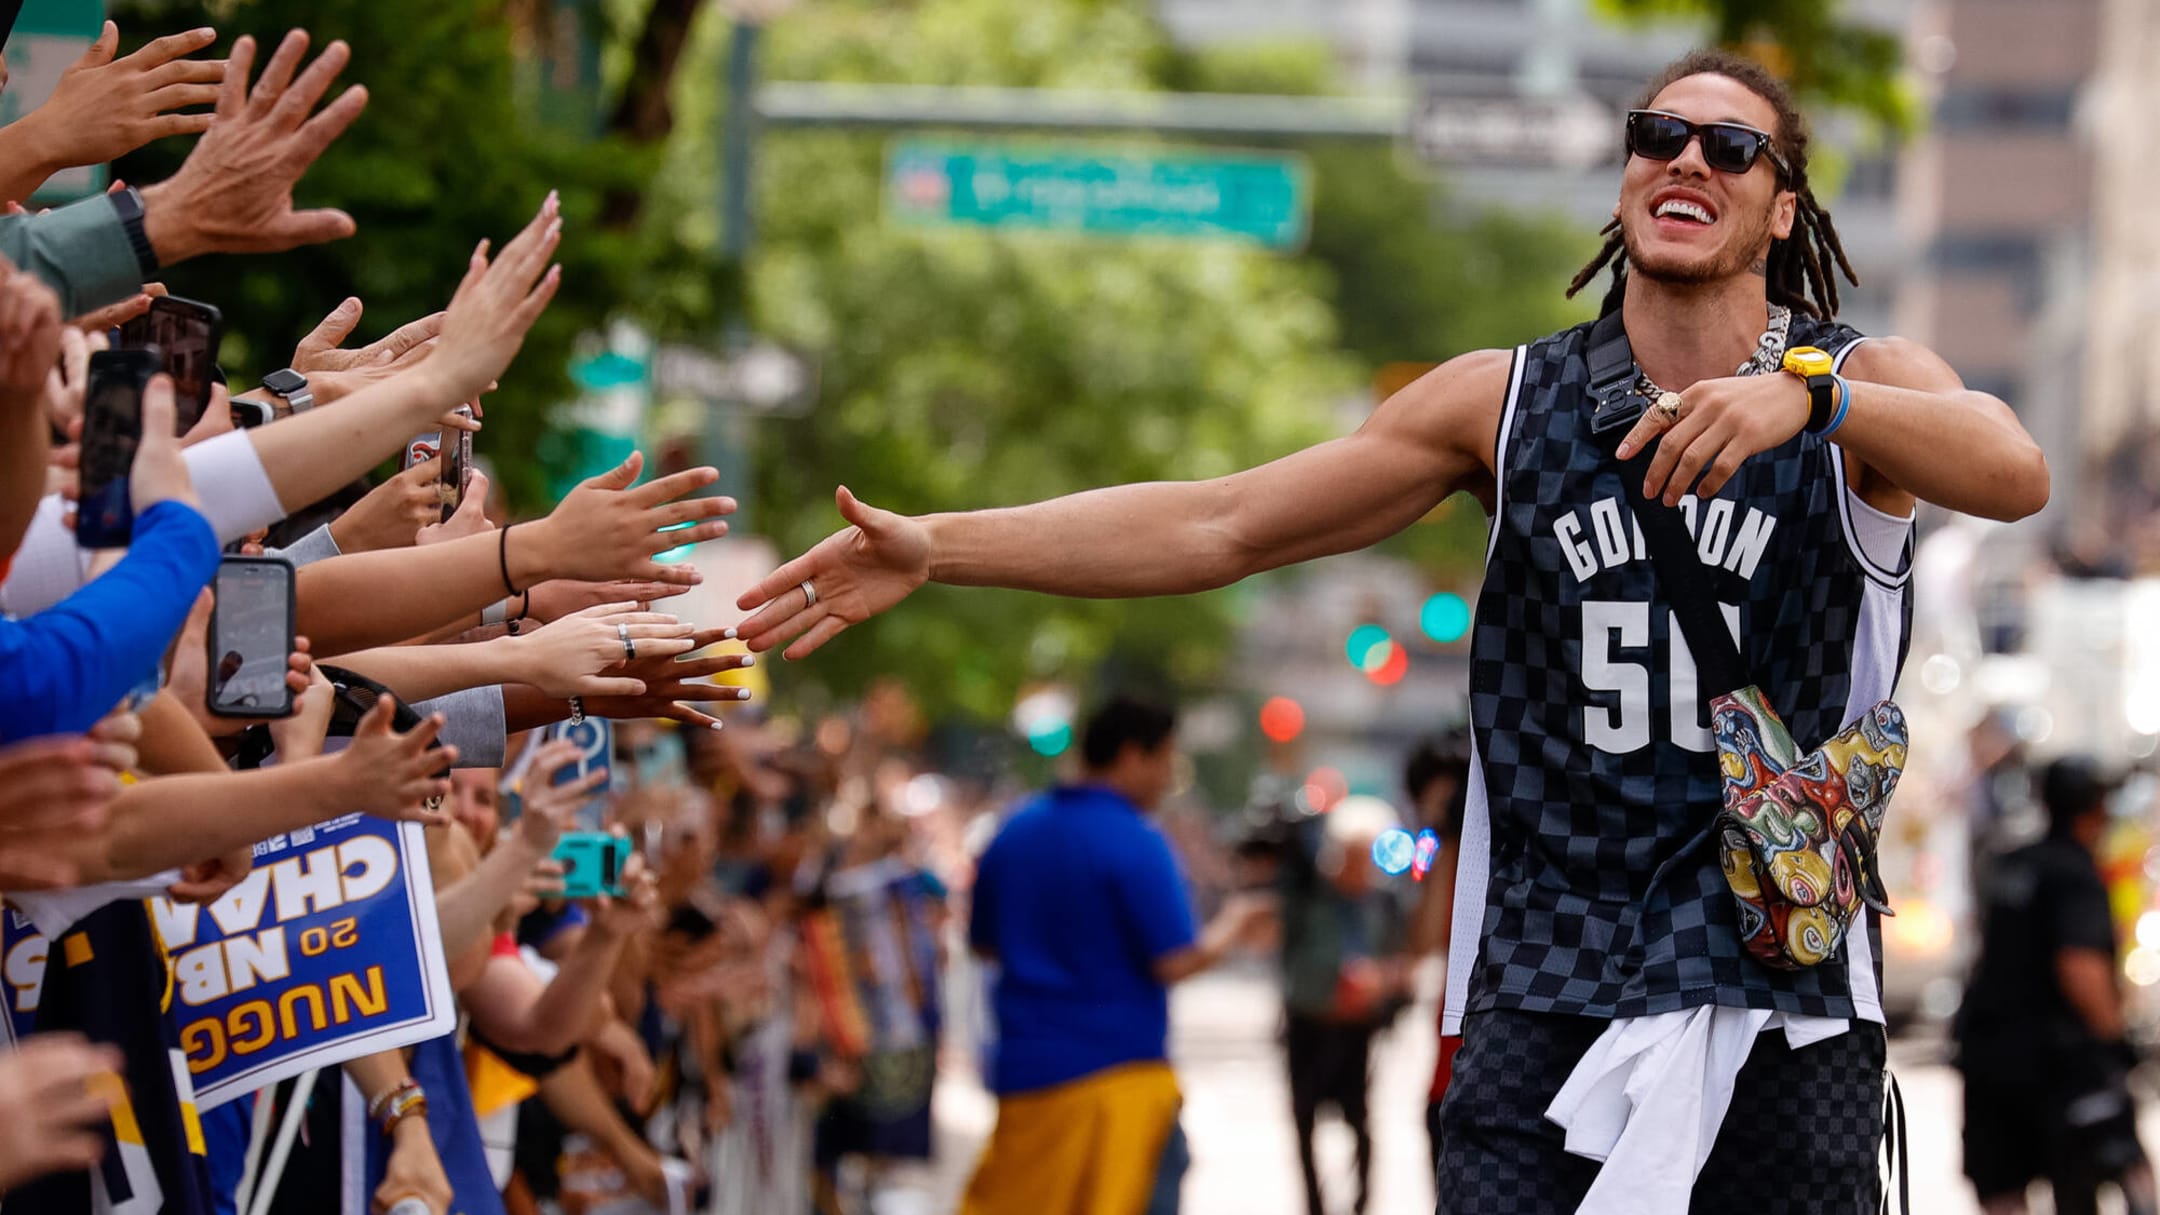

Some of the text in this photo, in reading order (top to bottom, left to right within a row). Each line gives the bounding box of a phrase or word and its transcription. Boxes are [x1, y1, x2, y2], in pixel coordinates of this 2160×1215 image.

[170, 916, 360, 1006] 20 NB
[180, 965, 388, 1075] NUGG
